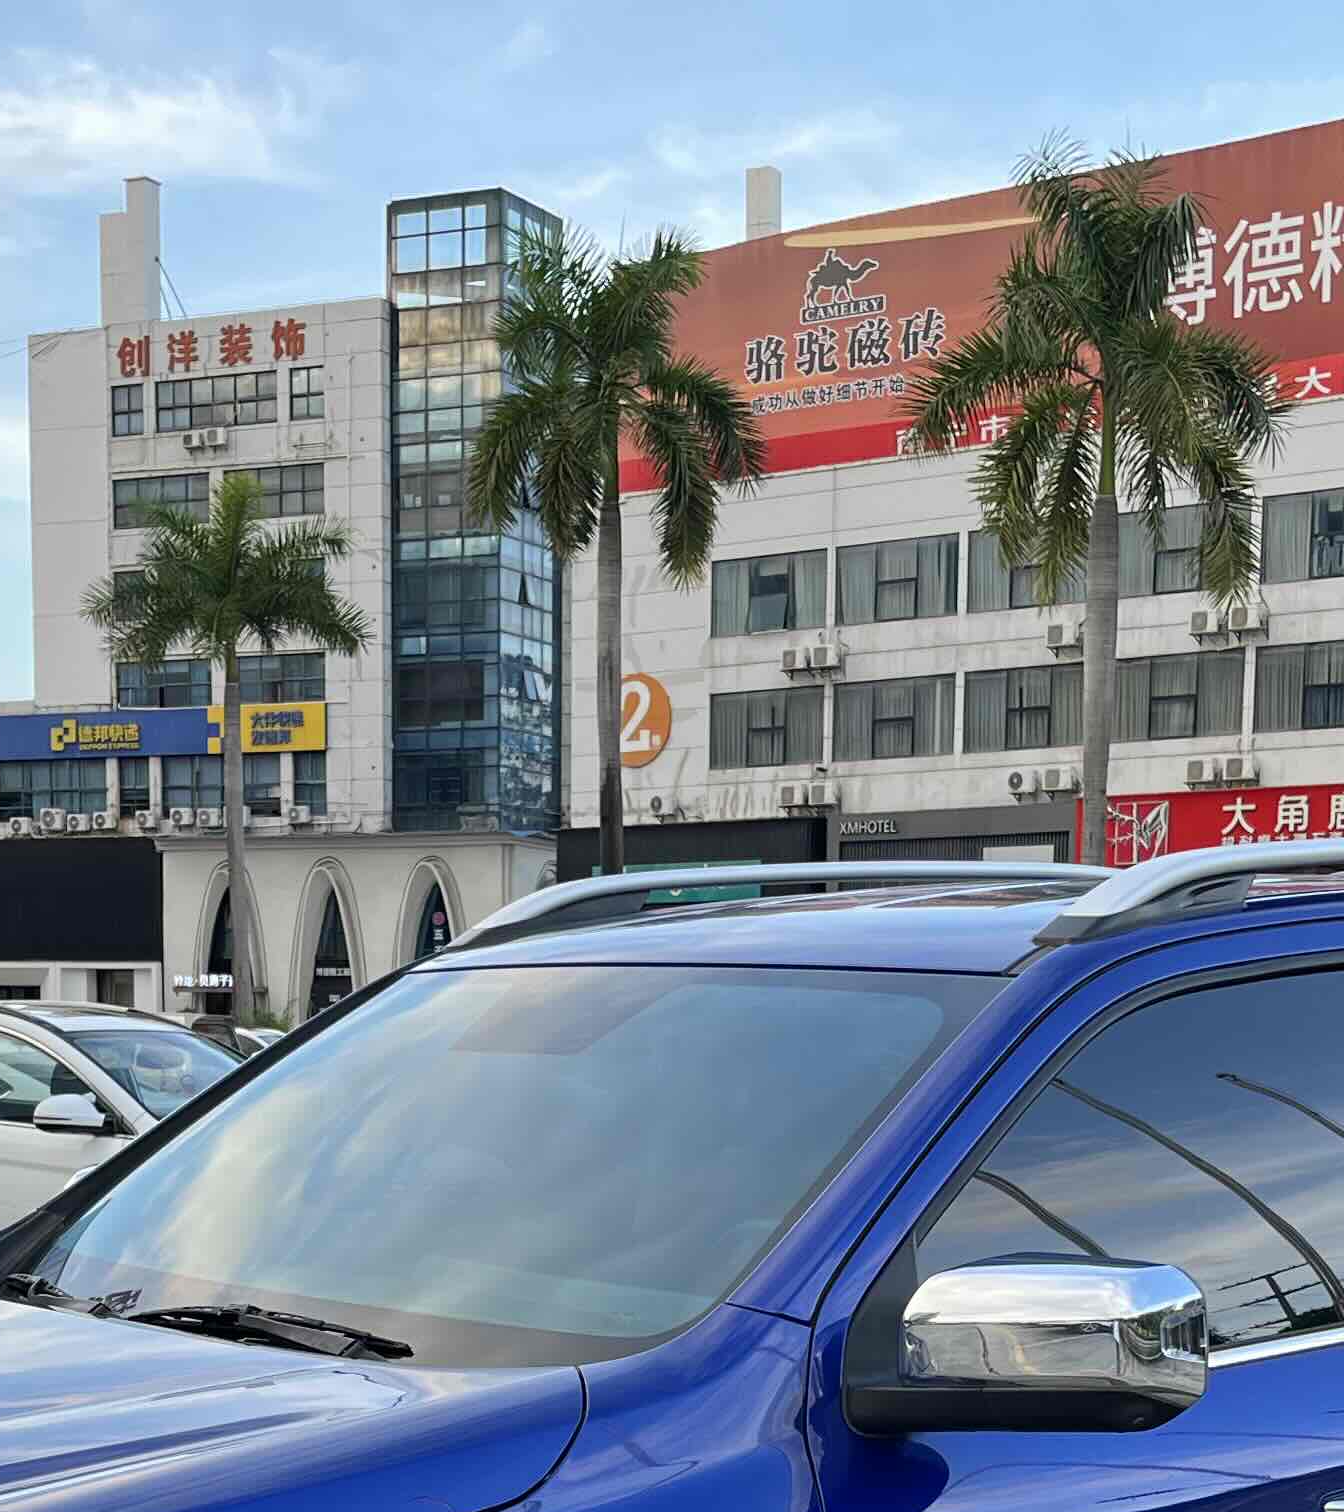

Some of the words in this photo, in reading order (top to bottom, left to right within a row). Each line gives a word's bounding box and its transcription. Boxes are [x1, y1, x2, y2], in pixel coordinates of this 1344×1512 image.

[803, 298, 884, 322] CAMELRY
[116, 318, 306, 378] 创洋装饰
[744, 307, 946, 386] 骆驼磁砖
[752, 373, 906, 417] 成功从做好细节开始
[620, 679, 653, 753] 2
